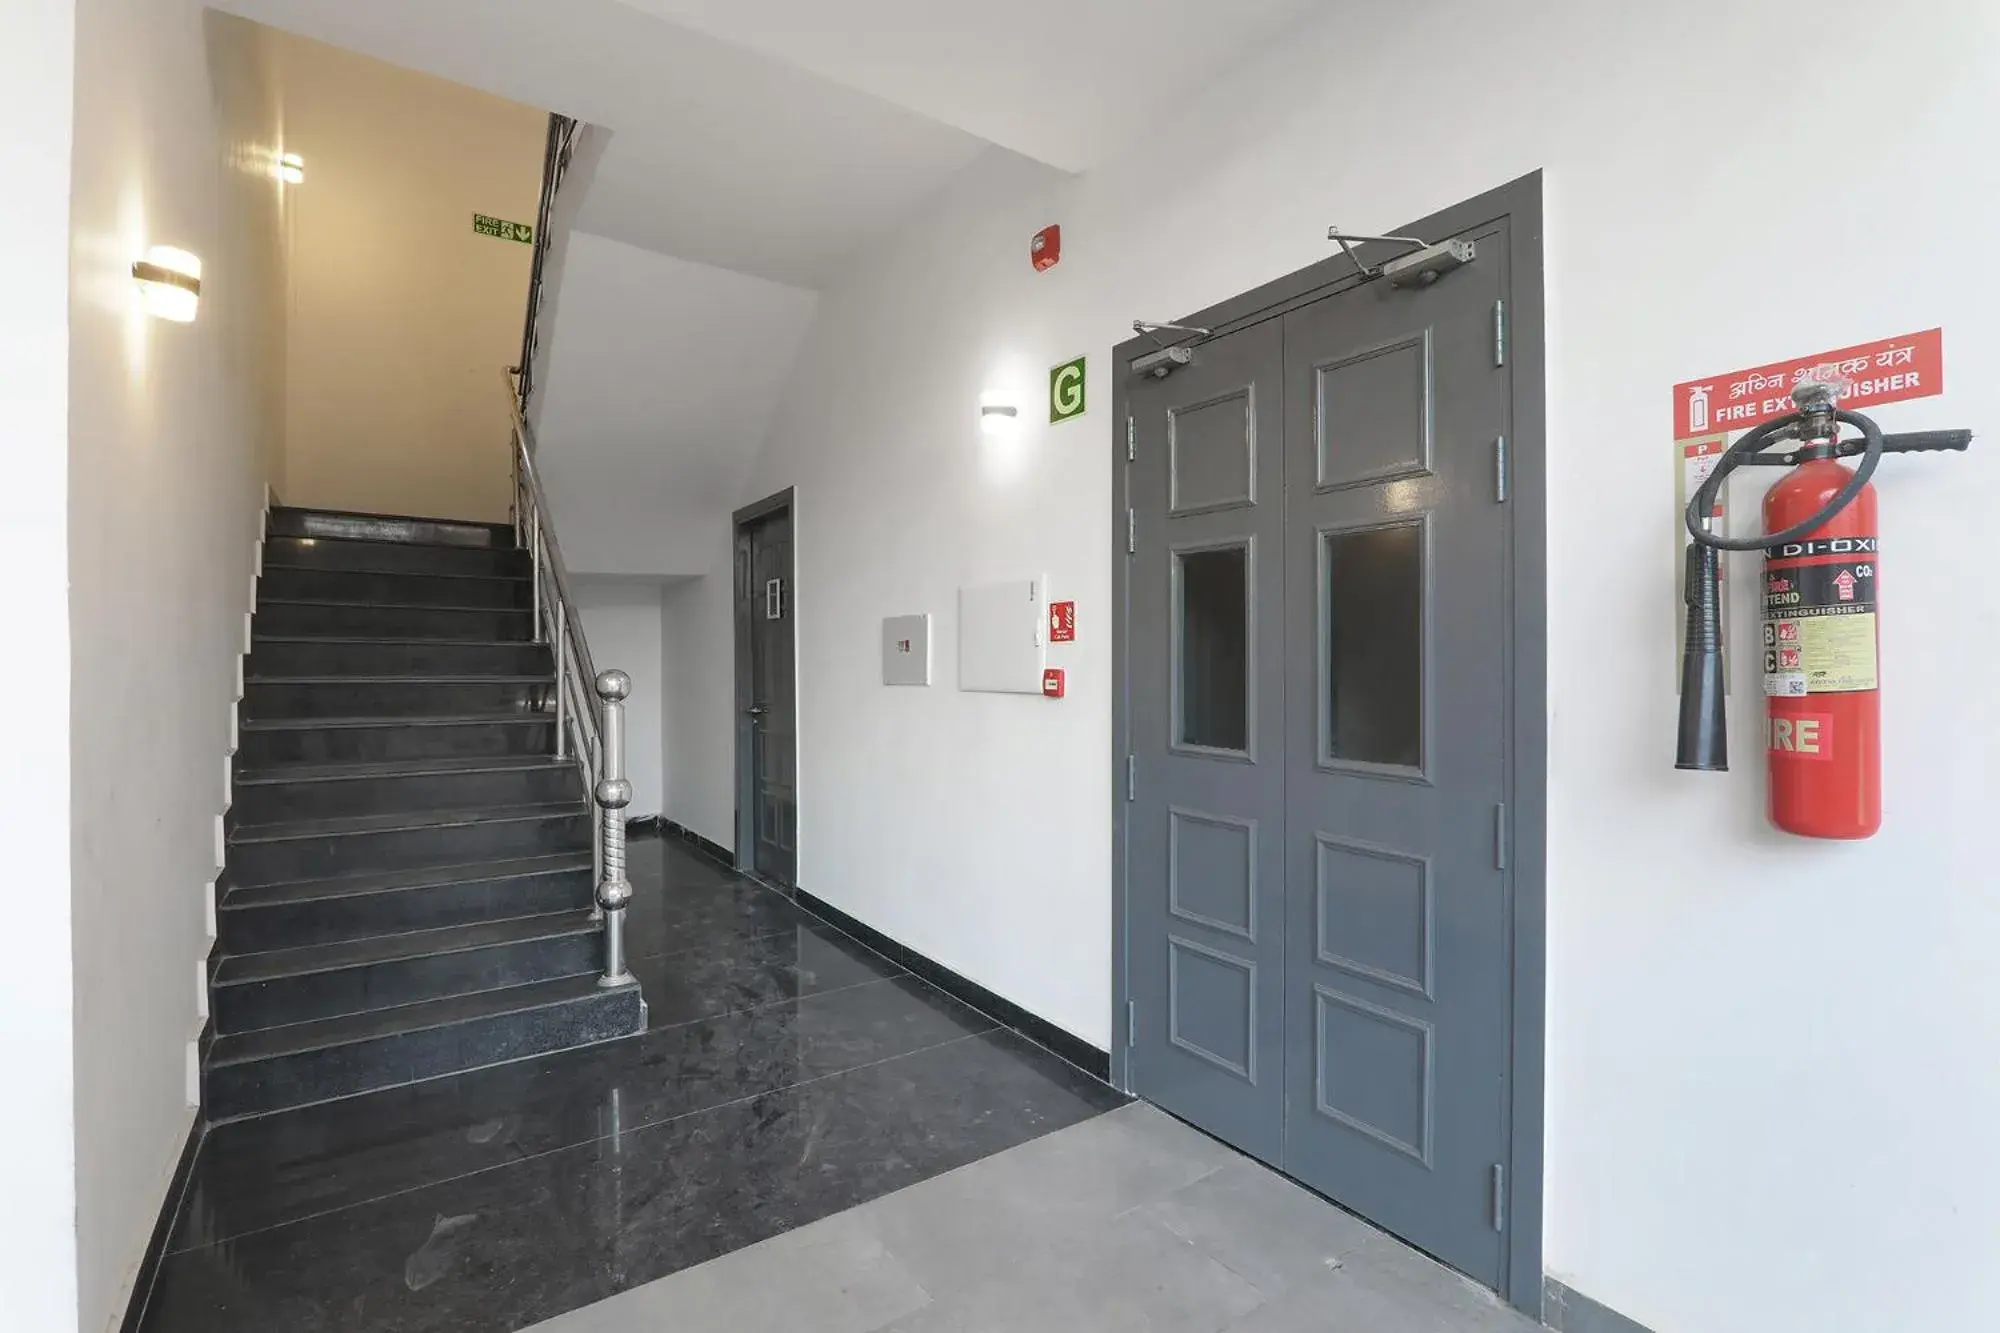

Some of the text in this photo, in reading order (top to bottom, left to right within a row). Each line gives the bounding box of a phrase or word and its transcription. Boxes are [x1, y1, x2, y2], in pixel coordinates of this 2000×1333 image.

[476, 216, 499, 226] FIRE
[476, 224, 498, 235] EXIT
[1874, 343, 1917, 368] यंत्र
[1054, 365, 1081, 415] G
[1716, 371, 1921, 422] FIRE EXTUISHER
[1763, 717, 1820, 753] IRE
